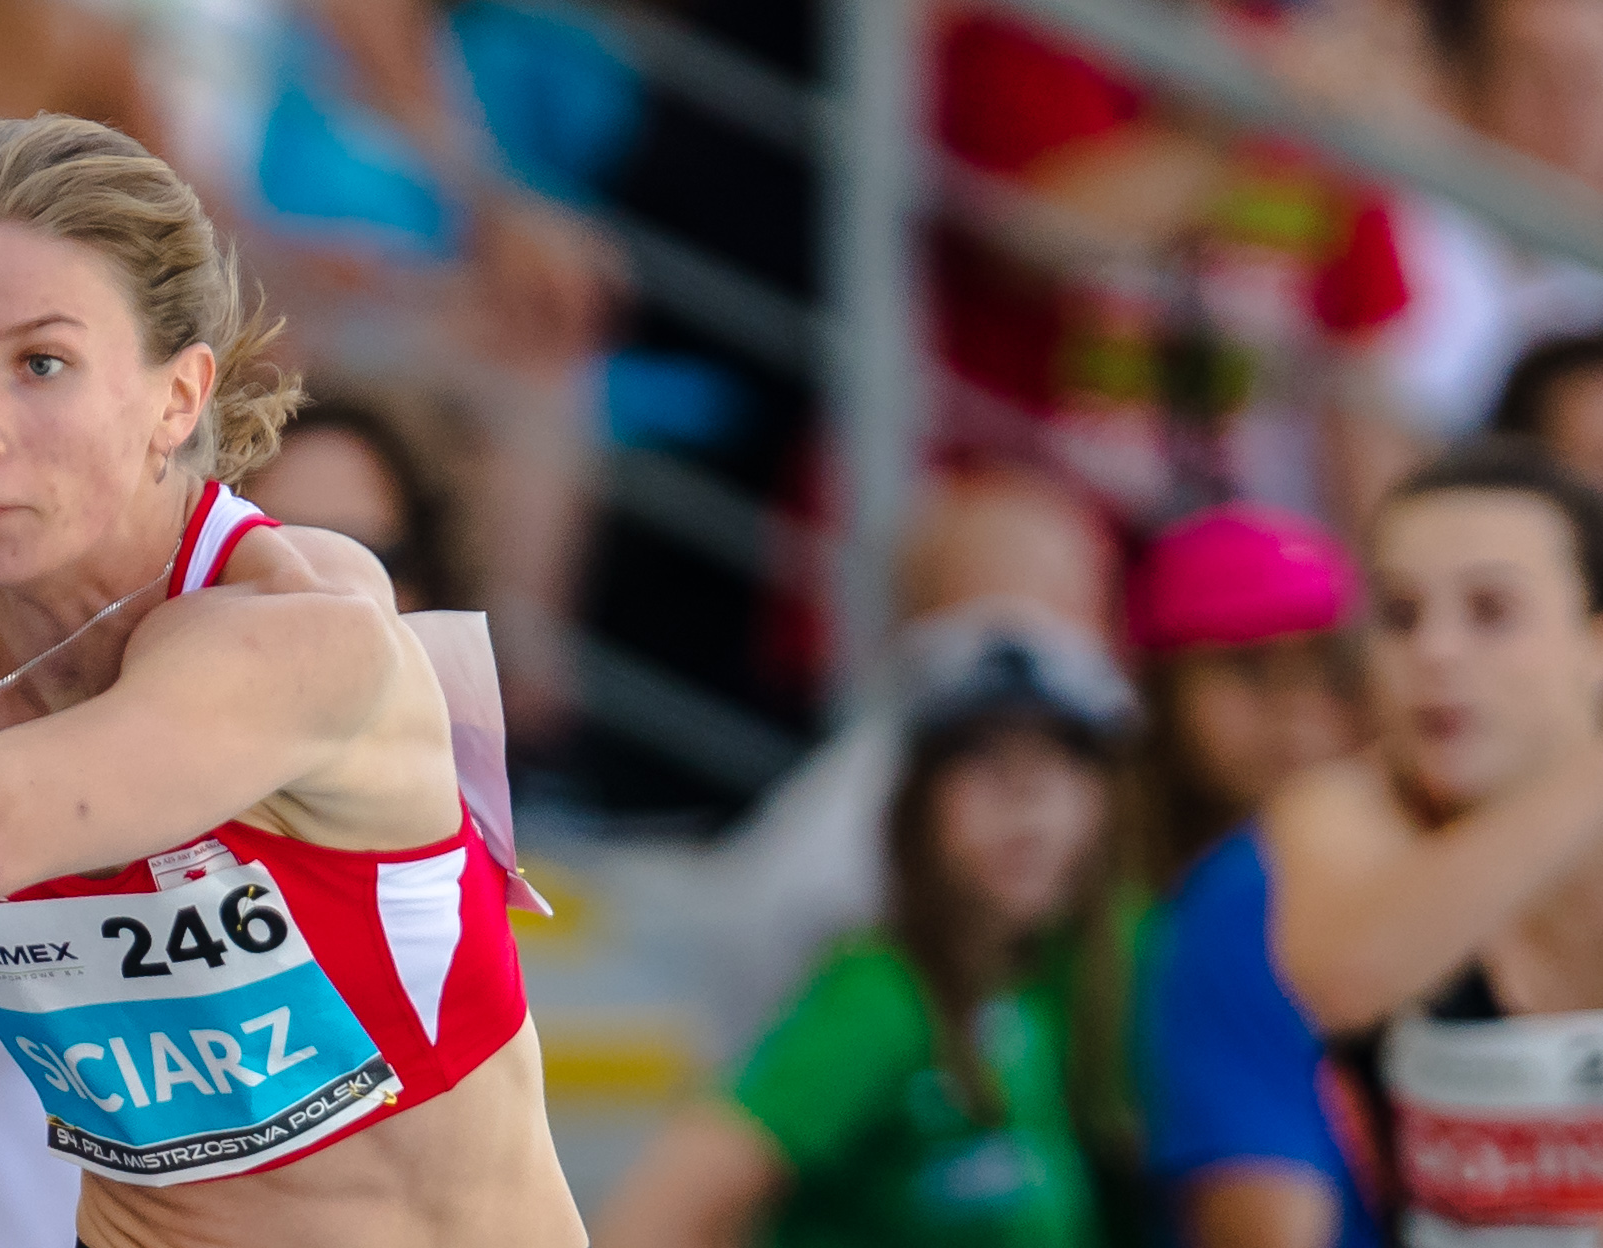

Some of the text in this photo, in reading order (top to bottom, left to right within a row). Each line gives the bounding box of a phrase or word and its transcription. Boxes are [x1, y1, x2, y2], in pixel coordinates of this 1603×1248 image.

[101, 884, 289, 979] 246
[15, 1005, 319, 1113] SICIARZ
[56, 1071, 374, 1169] 94. PZLA MISTRZOSTWA POLSKI
